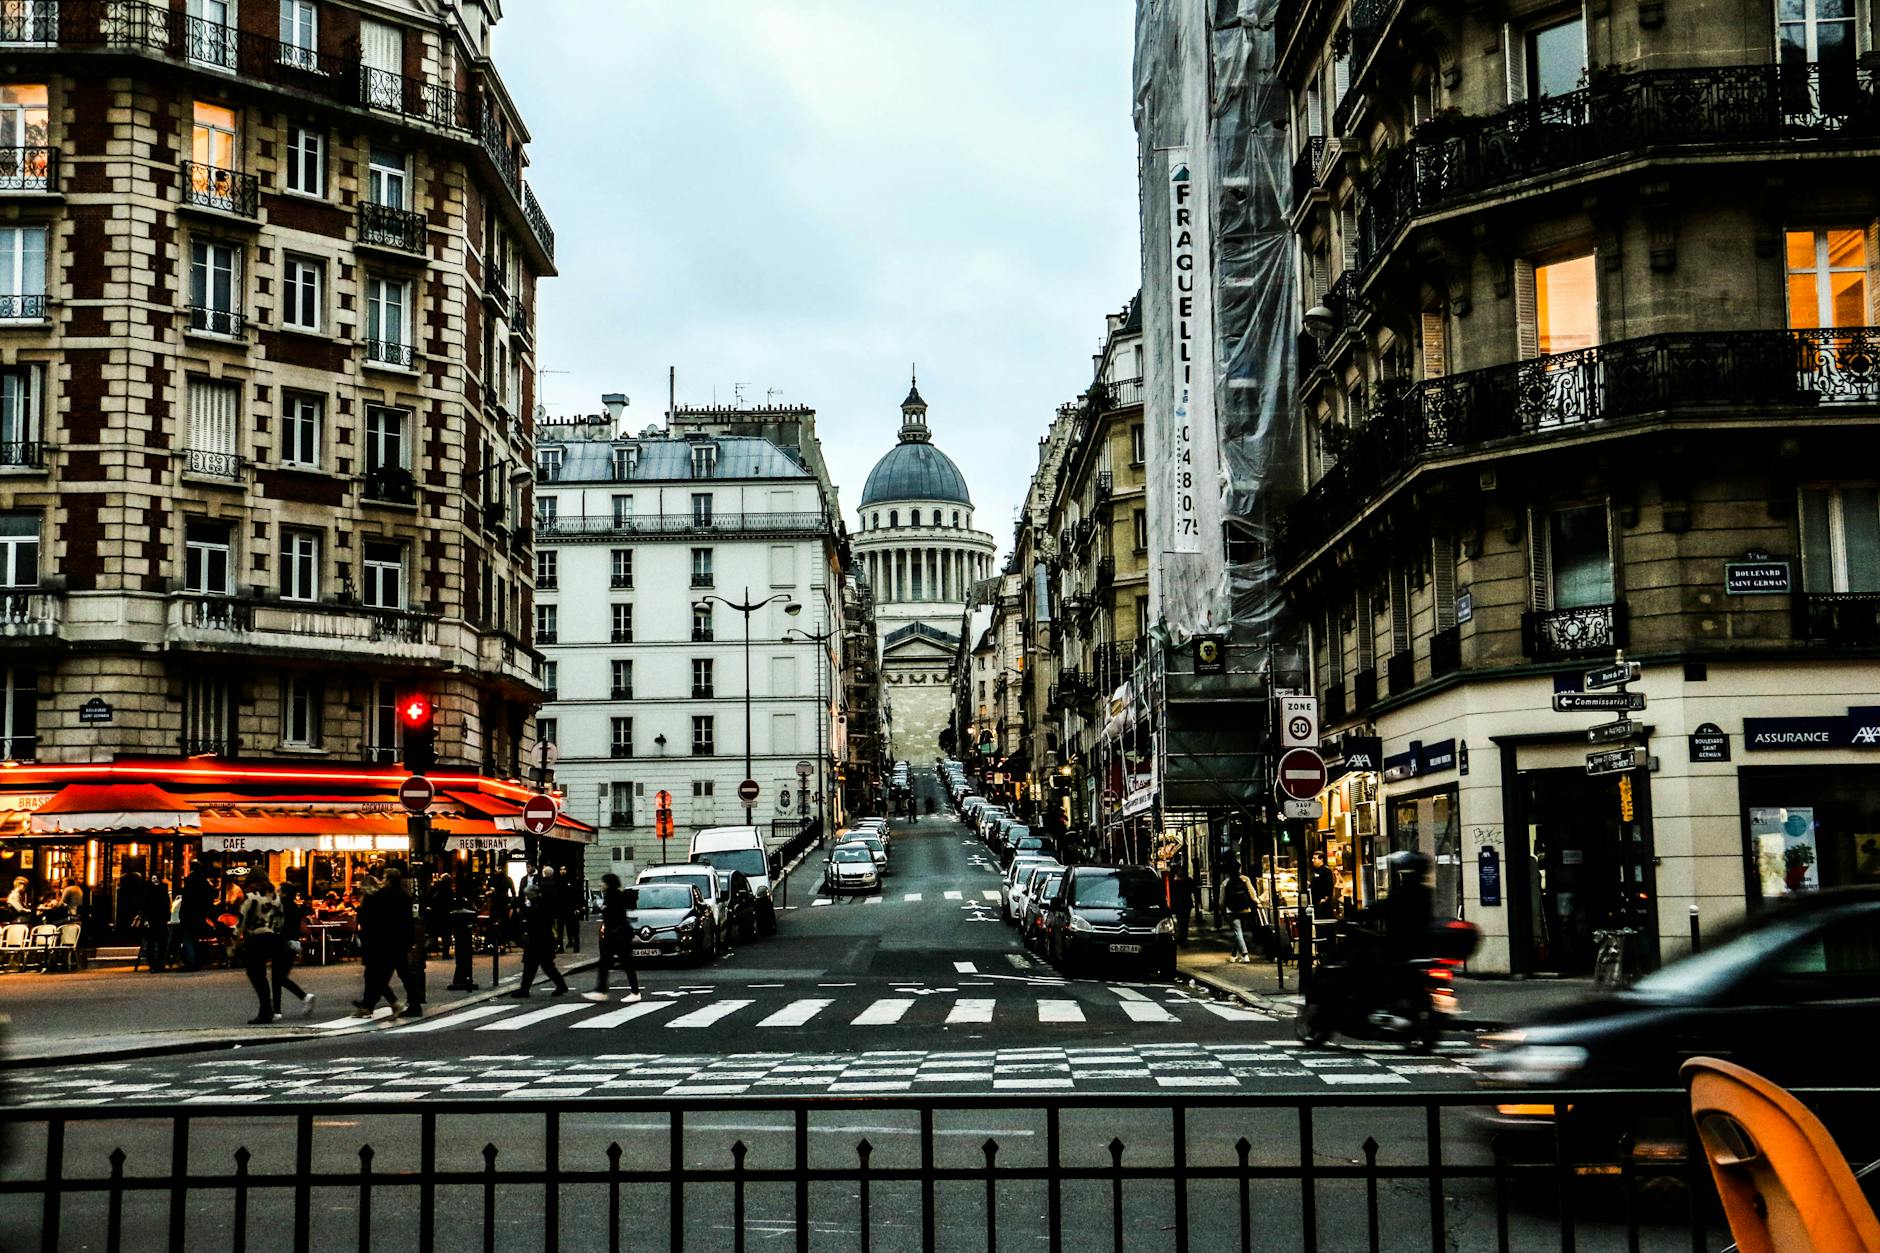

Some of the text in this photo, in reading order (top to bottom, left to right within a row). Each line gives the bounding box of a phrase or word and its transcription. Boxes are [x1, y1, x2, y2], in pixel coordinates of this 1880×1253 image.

[1176, 184, 1193, 384] FRAQUELLI
[1735, 569, 1780, 577] BOULEVARD
[1287, 703, 1312, 711] ZONE
[1574, 698, 1628, 706] Commissariat
[1293, 723, 1307, 734] 30
[1754, 732, 1829, 744] ASSURANCE
[1345, 754, 1372, 767] AXA
[223, 838, 246, 849] CAFE
[459, 838, 508, 849] RESTAURANT
